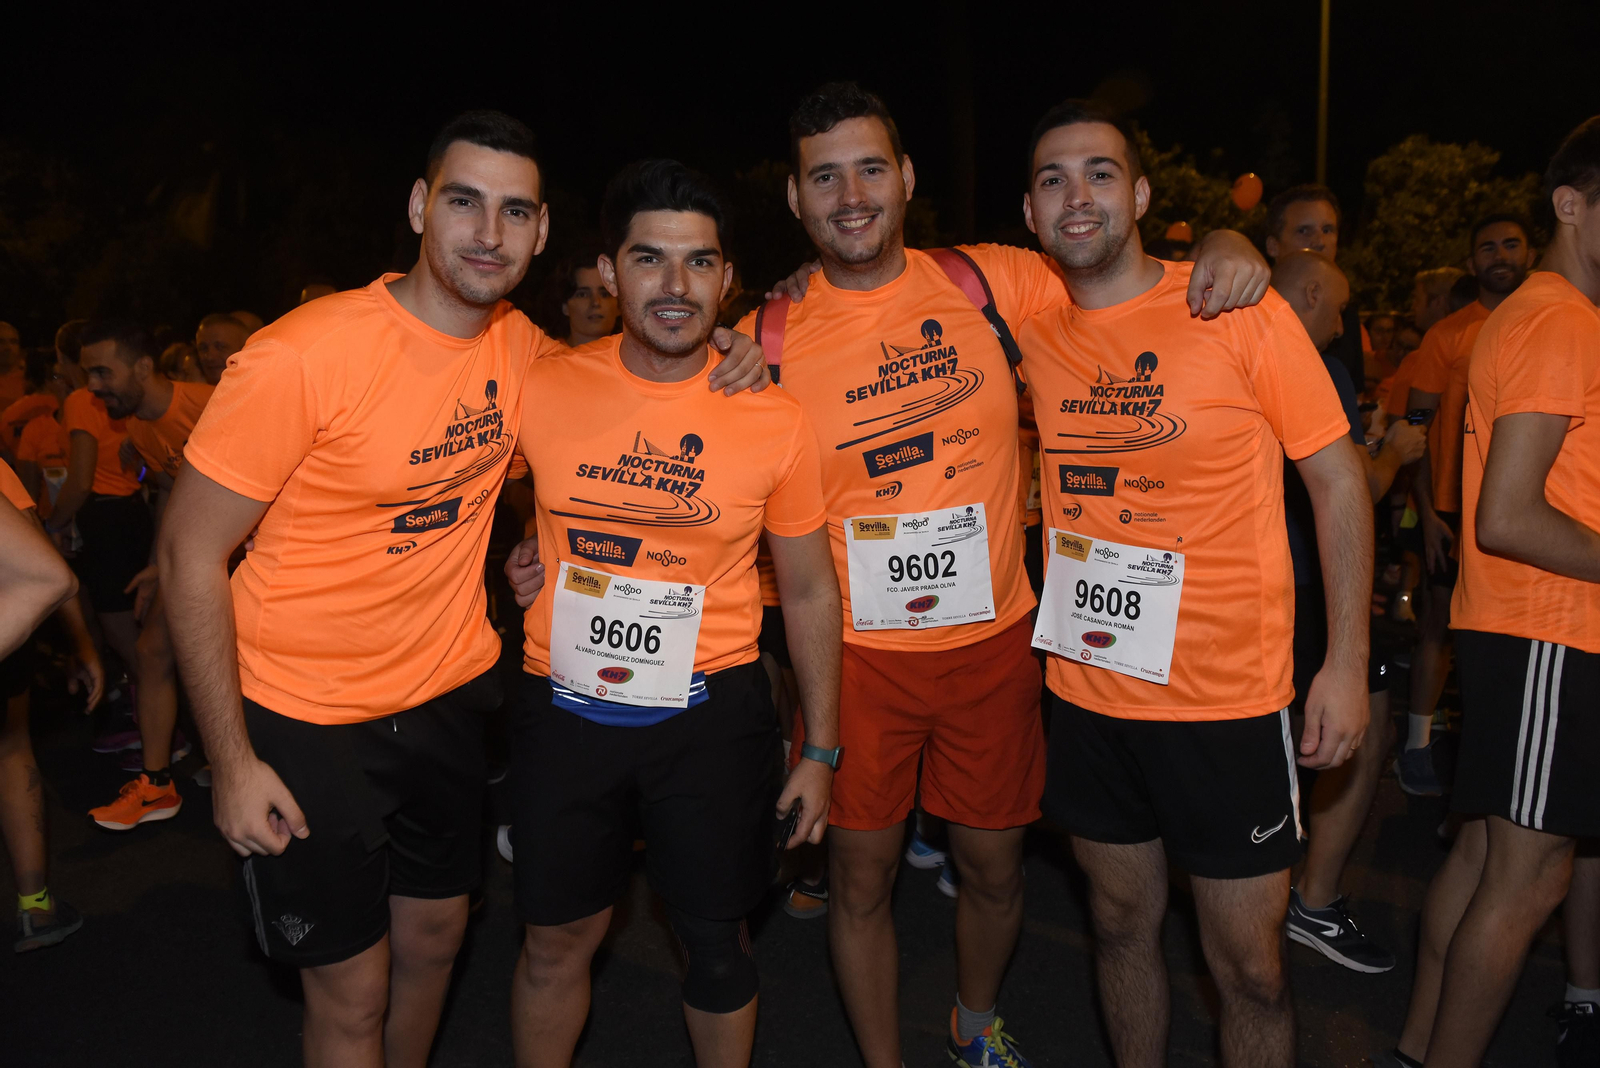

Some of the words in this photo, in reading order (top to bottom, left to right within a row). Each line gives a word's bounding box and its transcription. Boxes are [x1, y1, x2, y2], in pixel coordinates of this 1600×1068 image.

[878, 345, 958, 378] NOCTURNA
[845, 372, 920, 404] SEVILLA
[1089, 384, 1165, 398] NOCTURNA
[1059, 398, 1118, 416] SEVILLA
[445, 409, 504, 439] NOCTURN
[408, 435, 475, 465] SEVILLA
[575, 463, 653, 489] SEVILLA
[617, 454, 706, 482] NOCTURNA
[937, 523, 963, 533] SEVILLA
[949, 516, 977, 525] NOCTURNA
[888, 549, 957, 582] 9602
[1127, 563, 1156, 573] SEVILLA
[1141, 560, 1174, 570] NOCTURNA
[900, 585, 920, 593] JAVIER
[939, 581, 956, 590] OLIVA
[649, 598, 677, 607] SEVILLA
[663, 594, 694, 602] NOCTURNA
[1074, 578, 1141, 621] 9608
[1070, 611, 1083, 621] JOSÉ
[1083, 615, 1113, 628] CASANOVA
[1113, 622, 1135, 632] ROMÁN
[589, 615, 662, 655] 9606
[574, 644, 596, 656] ÁLVARO
[596, 650, 630, 663] DOMÍNGUEZ
[631, 656, 665, 667] DOMÍNGUEZ
[1140, 667, 1165, 678] Cruzcampo
